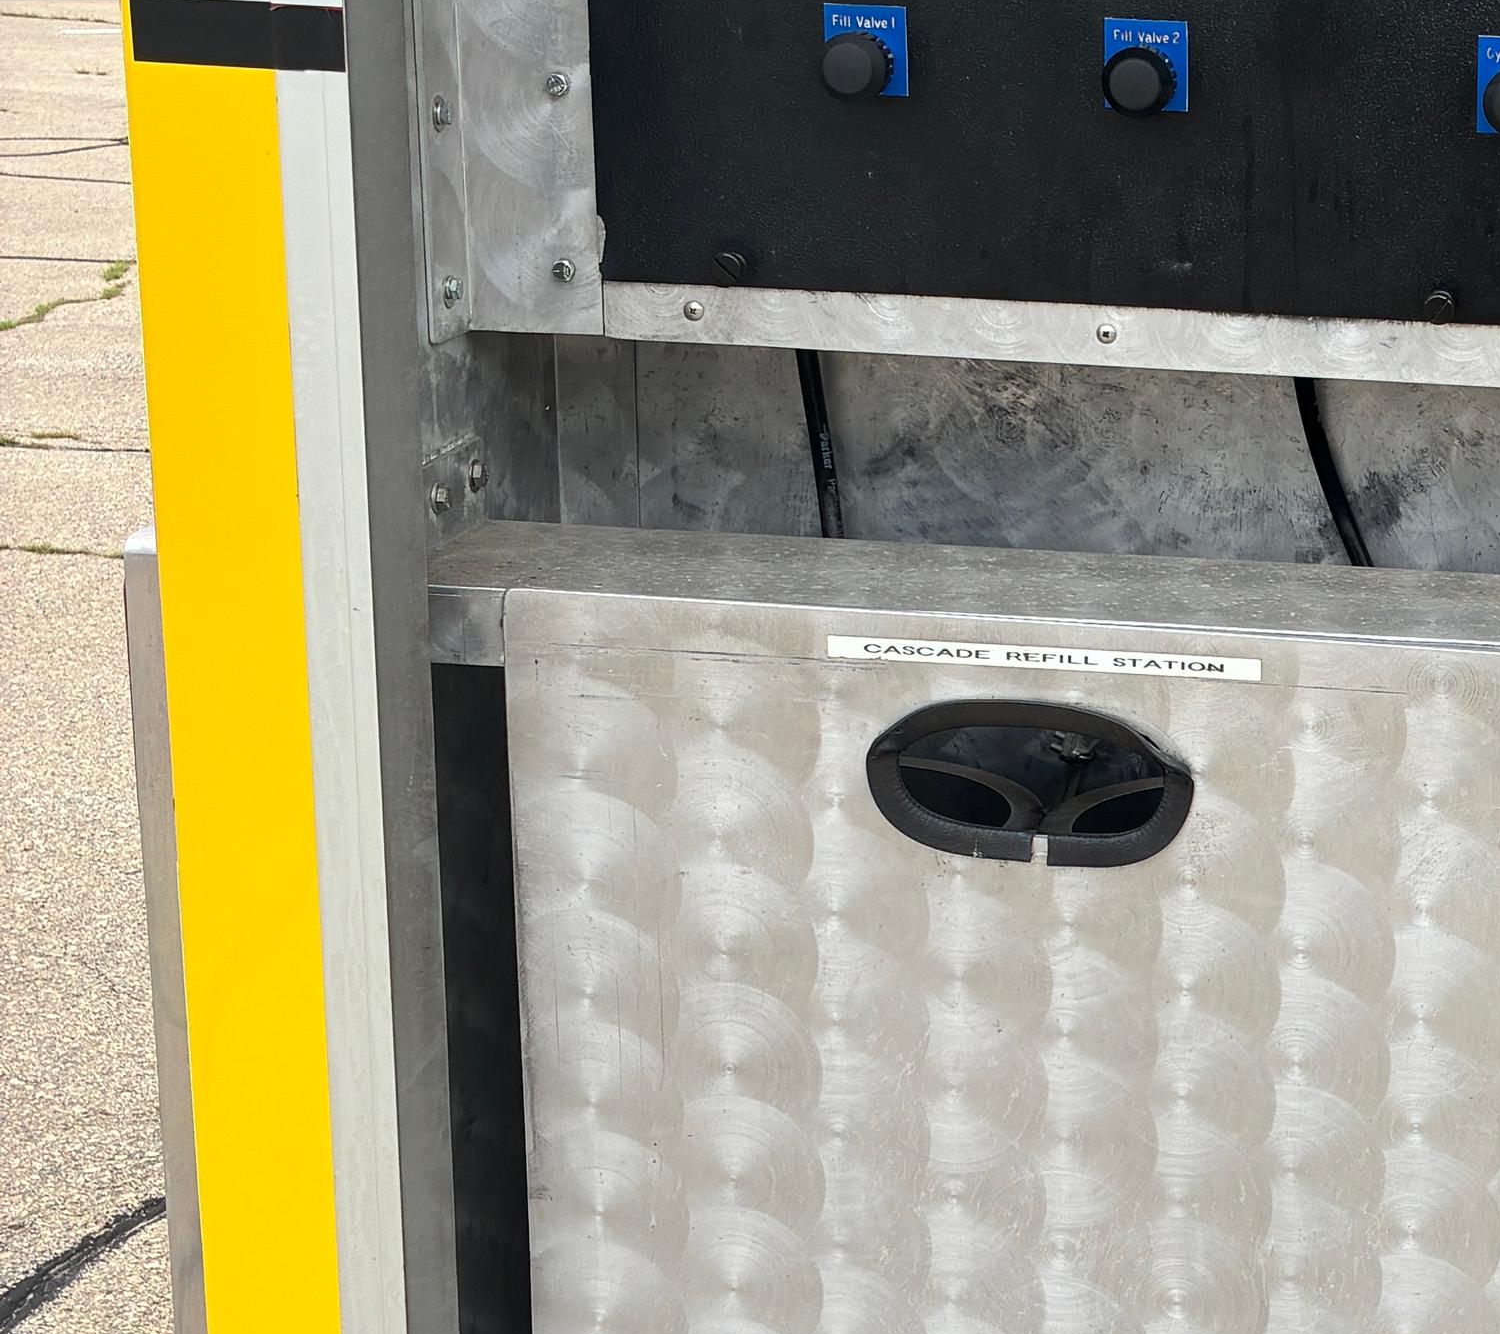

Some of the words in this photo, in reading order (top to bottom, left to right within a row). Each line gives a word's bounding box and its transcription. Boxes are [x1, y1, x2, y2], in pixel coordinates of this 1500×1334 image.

[832, 14, 851, 27] Fill
[856, 16, 888, 28] Valve
[1113, 29, 1132, 42] Fill
[1138, 31, 1169, 44] Valve
[1172, 32, 1180, 44] 2
[820, 433, 833, 470] Parker
[863, 642, 991, 661] CASCADE
[1005, 651, 1099, 667] REFILL
[1112, 657, 1226, 674] STATION
